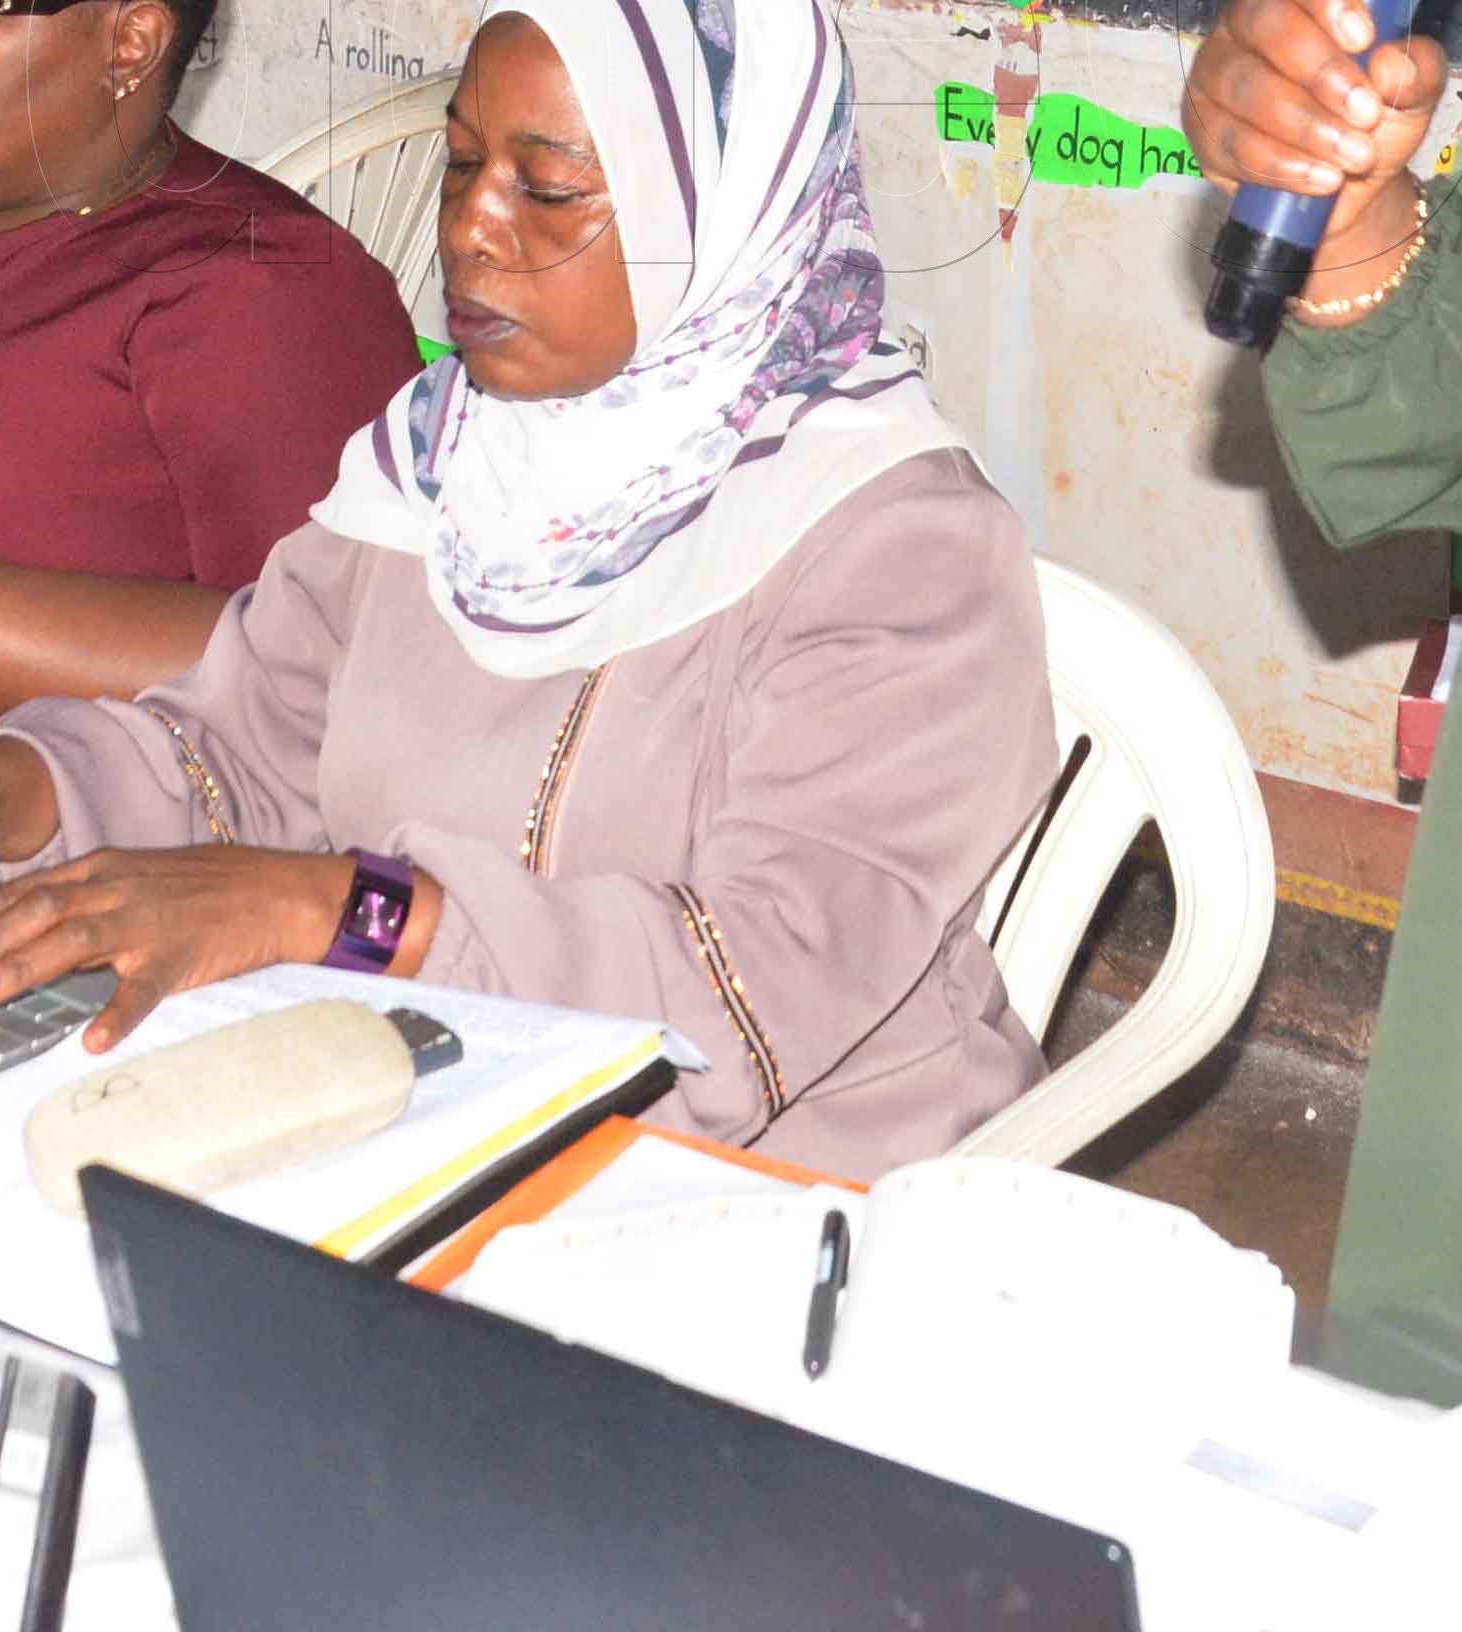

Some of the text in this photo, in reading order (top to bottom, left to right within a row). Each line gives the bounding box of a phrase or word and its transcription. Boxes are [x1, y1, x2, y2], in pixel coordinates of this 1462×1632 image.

[314, 18, 335, 63] A
[943, 87, 1042, 156] Evey
[1056, 105, 1124, 187] dog
